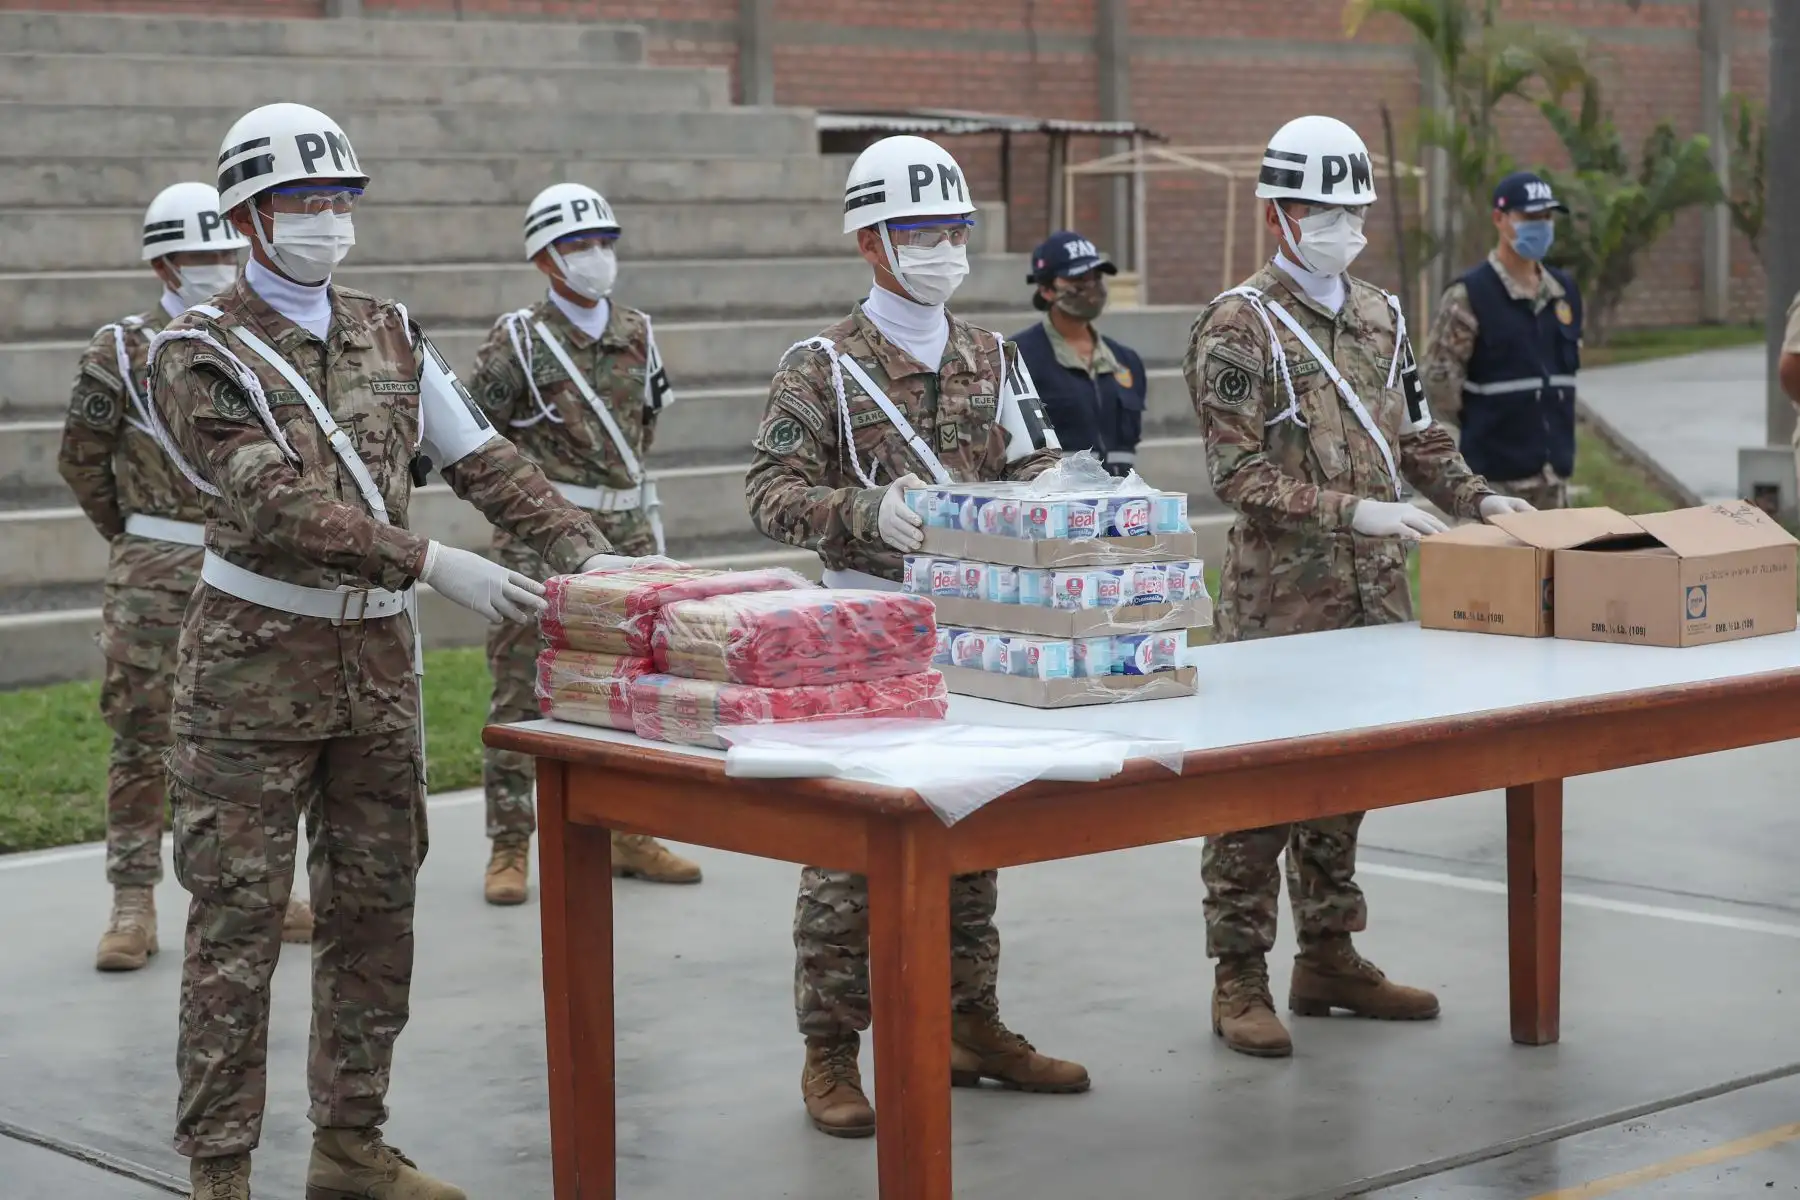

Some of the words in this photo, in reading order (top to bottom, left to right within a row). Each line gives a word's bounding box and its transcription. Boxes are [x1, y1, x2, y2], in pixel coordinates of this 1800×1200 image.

[295, 131, 359, 174] PM
[1322, 152, 1371, 194] PM
[908, 164, 963, 202] PM
[374, 383, 415, 391] EJERCITO
[975, 397, 996, 405] EJER
[858, 411, 885, 424] SANC
[1591, 623, 1607, 633] EMB.
[1629, 625, 1646, 637] (109)
